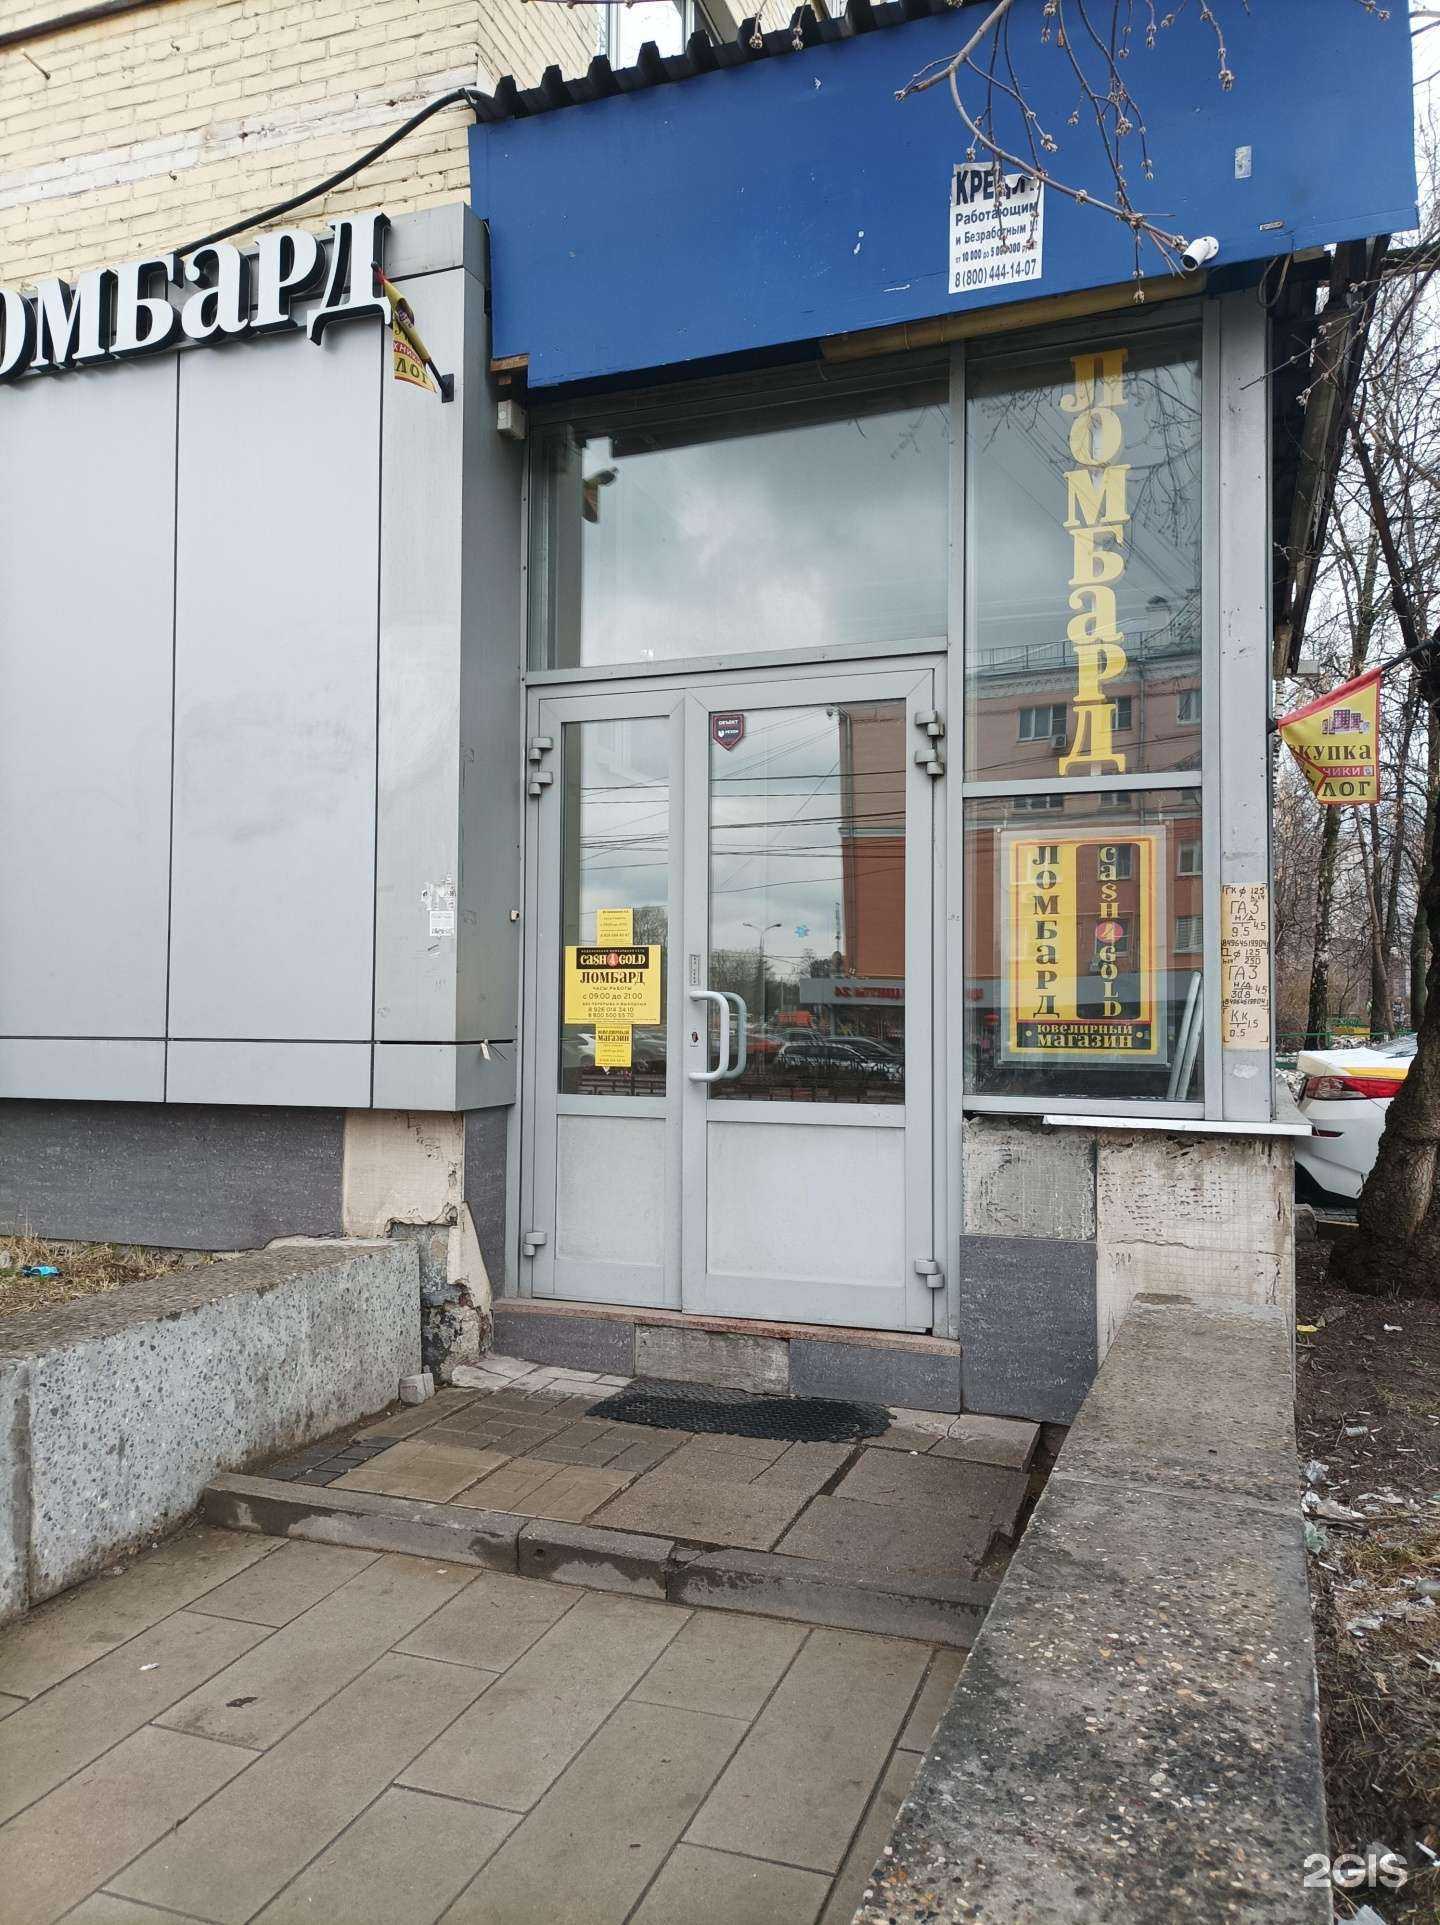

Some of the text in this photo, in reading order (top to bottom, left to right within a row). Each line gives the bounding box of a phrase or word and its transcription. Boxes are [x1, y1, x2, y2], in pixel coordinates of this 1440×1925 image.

[956, 202, 1038, 227] Работающим
[965, 224, 1026, 244] Безработным
[955, 258, 1037, 289] 8 (800) 444-14-07
